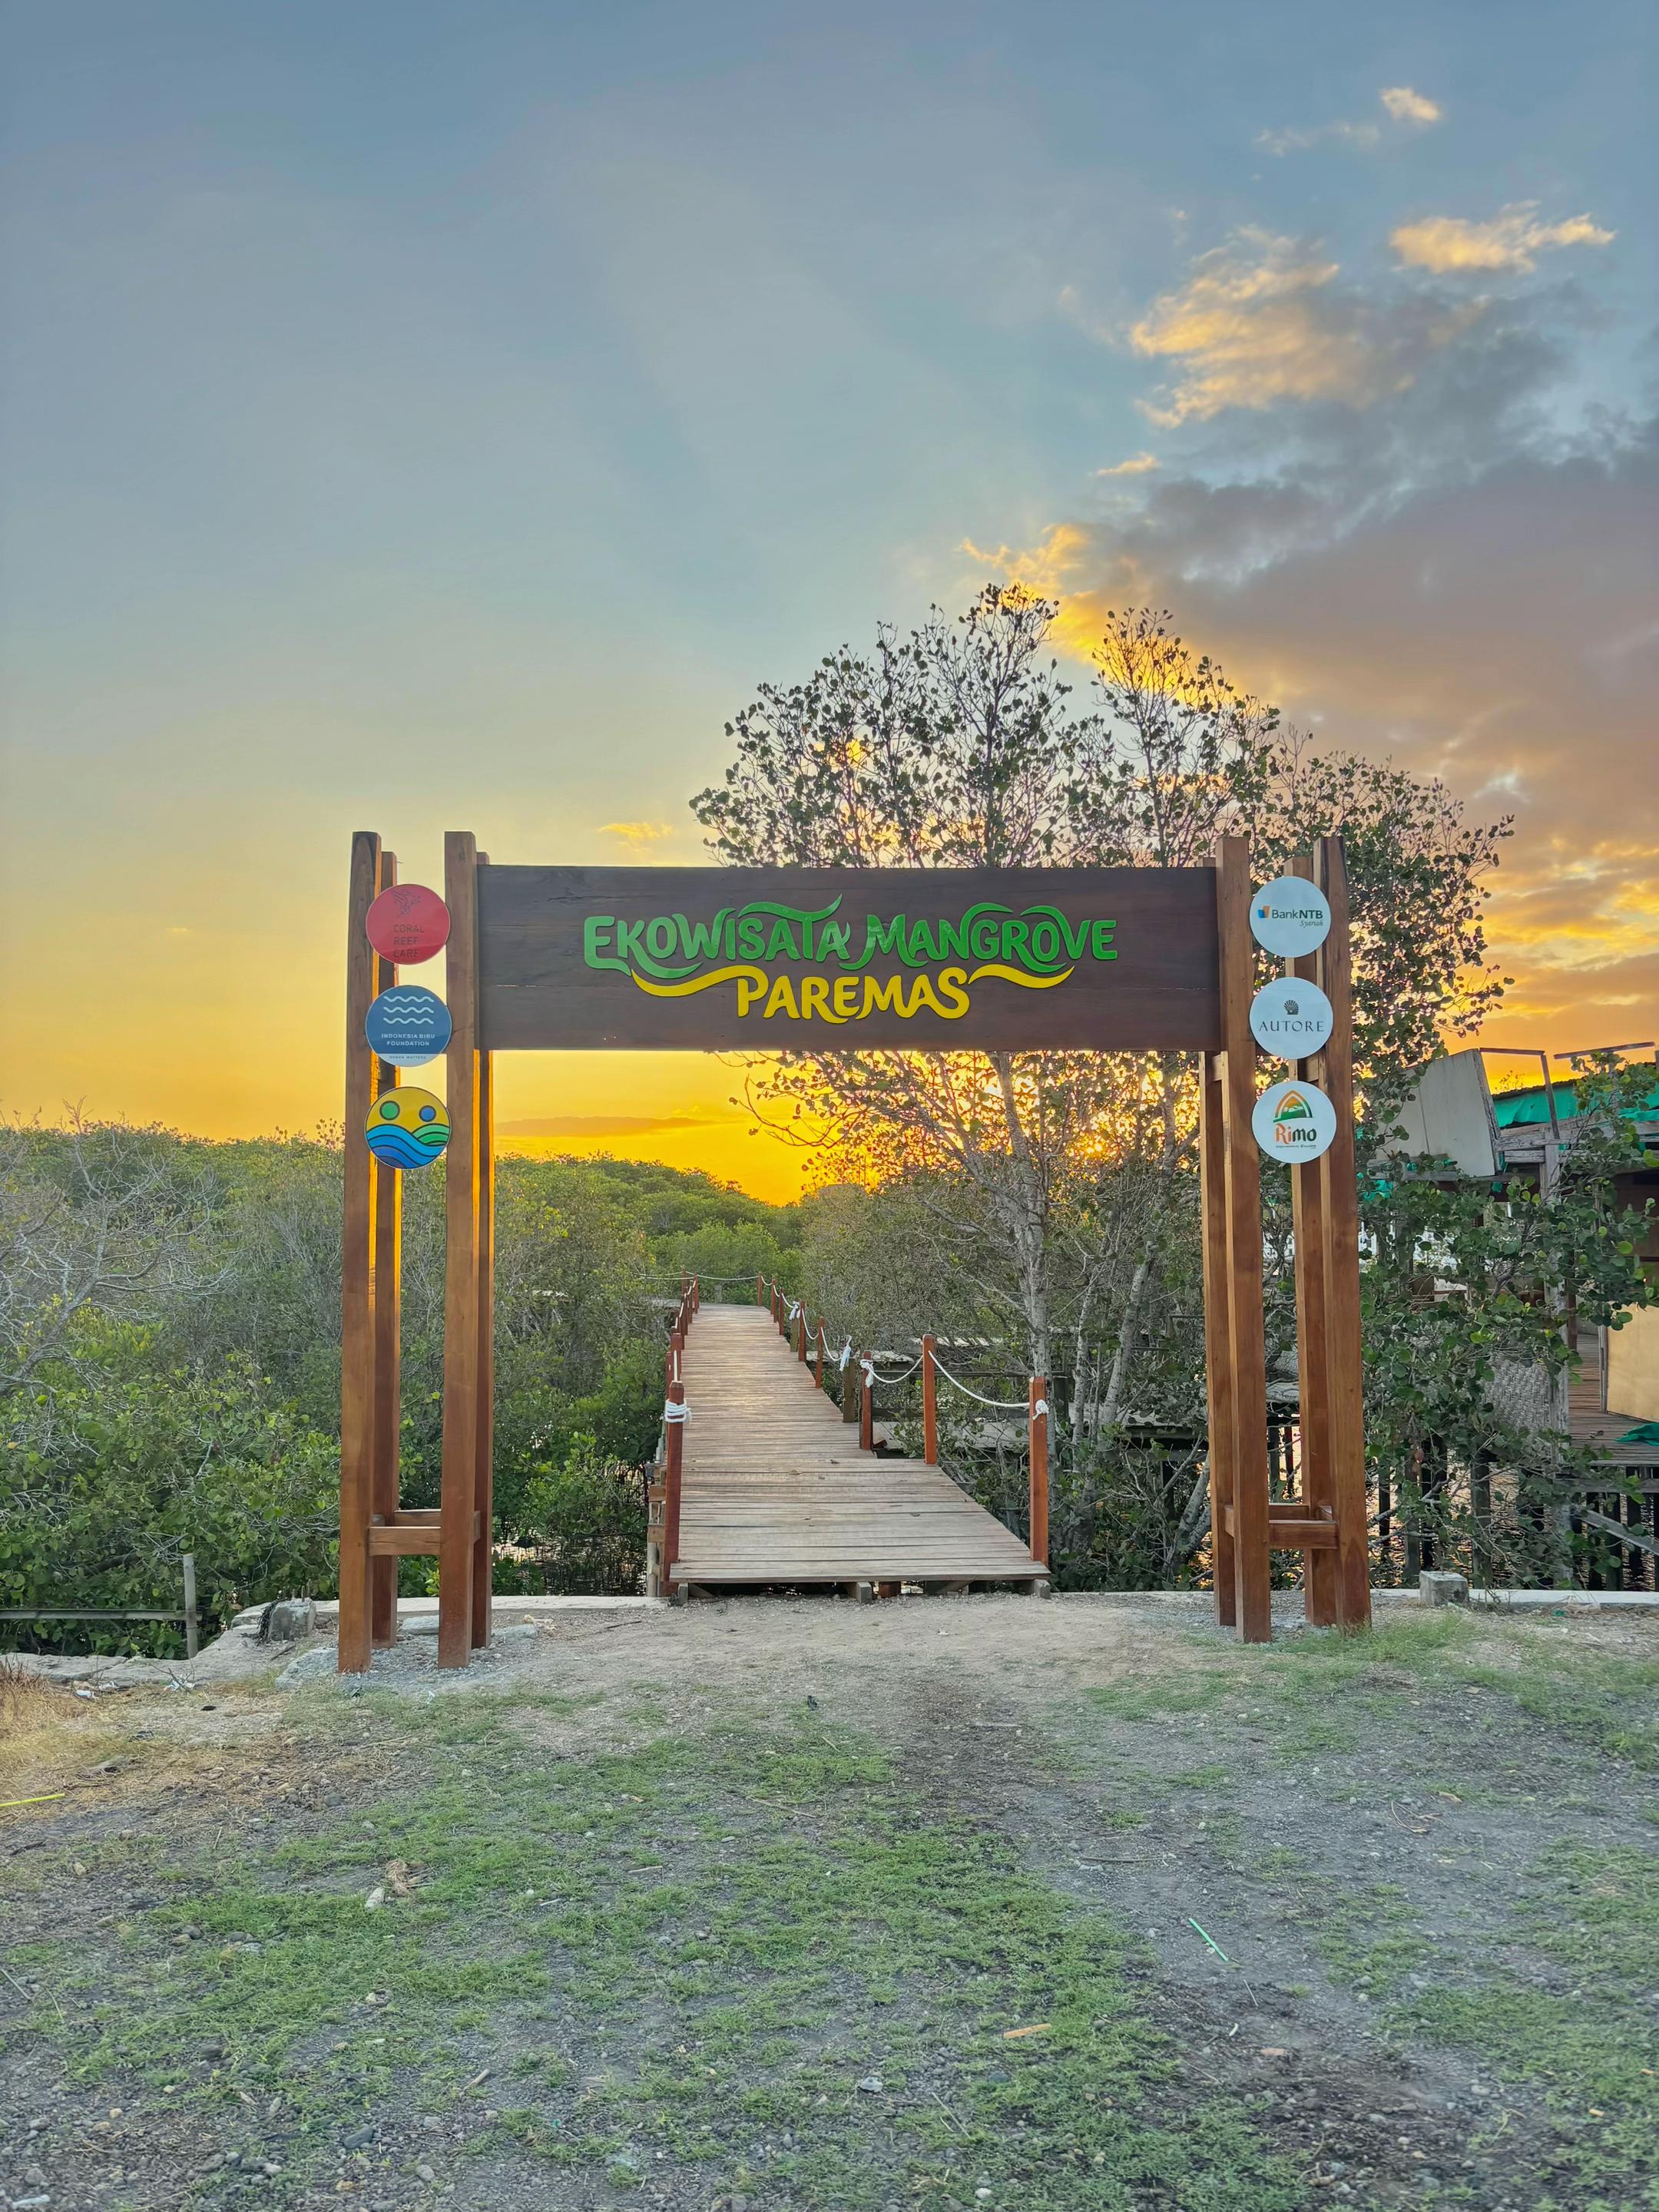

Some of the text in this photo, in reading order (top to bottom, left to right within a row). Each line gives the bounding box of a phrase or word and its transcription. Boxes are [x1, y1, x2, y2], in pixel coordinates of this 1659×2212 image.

[1272, 909, 1323, 919] BankNTB
[392, 924, 425, 934] CORAL
[392, 936, 419, 945] REEF
[584, 894, 1118, 979] EKOWISATA MANGROVE
[392, 949, 419, 959] CARE
[631, 965, 971, 1024] PAREMAS
[1259, 1020, 1325, 1032] AUTORE
[1275, 1122, 1317, 1144] Rimo
